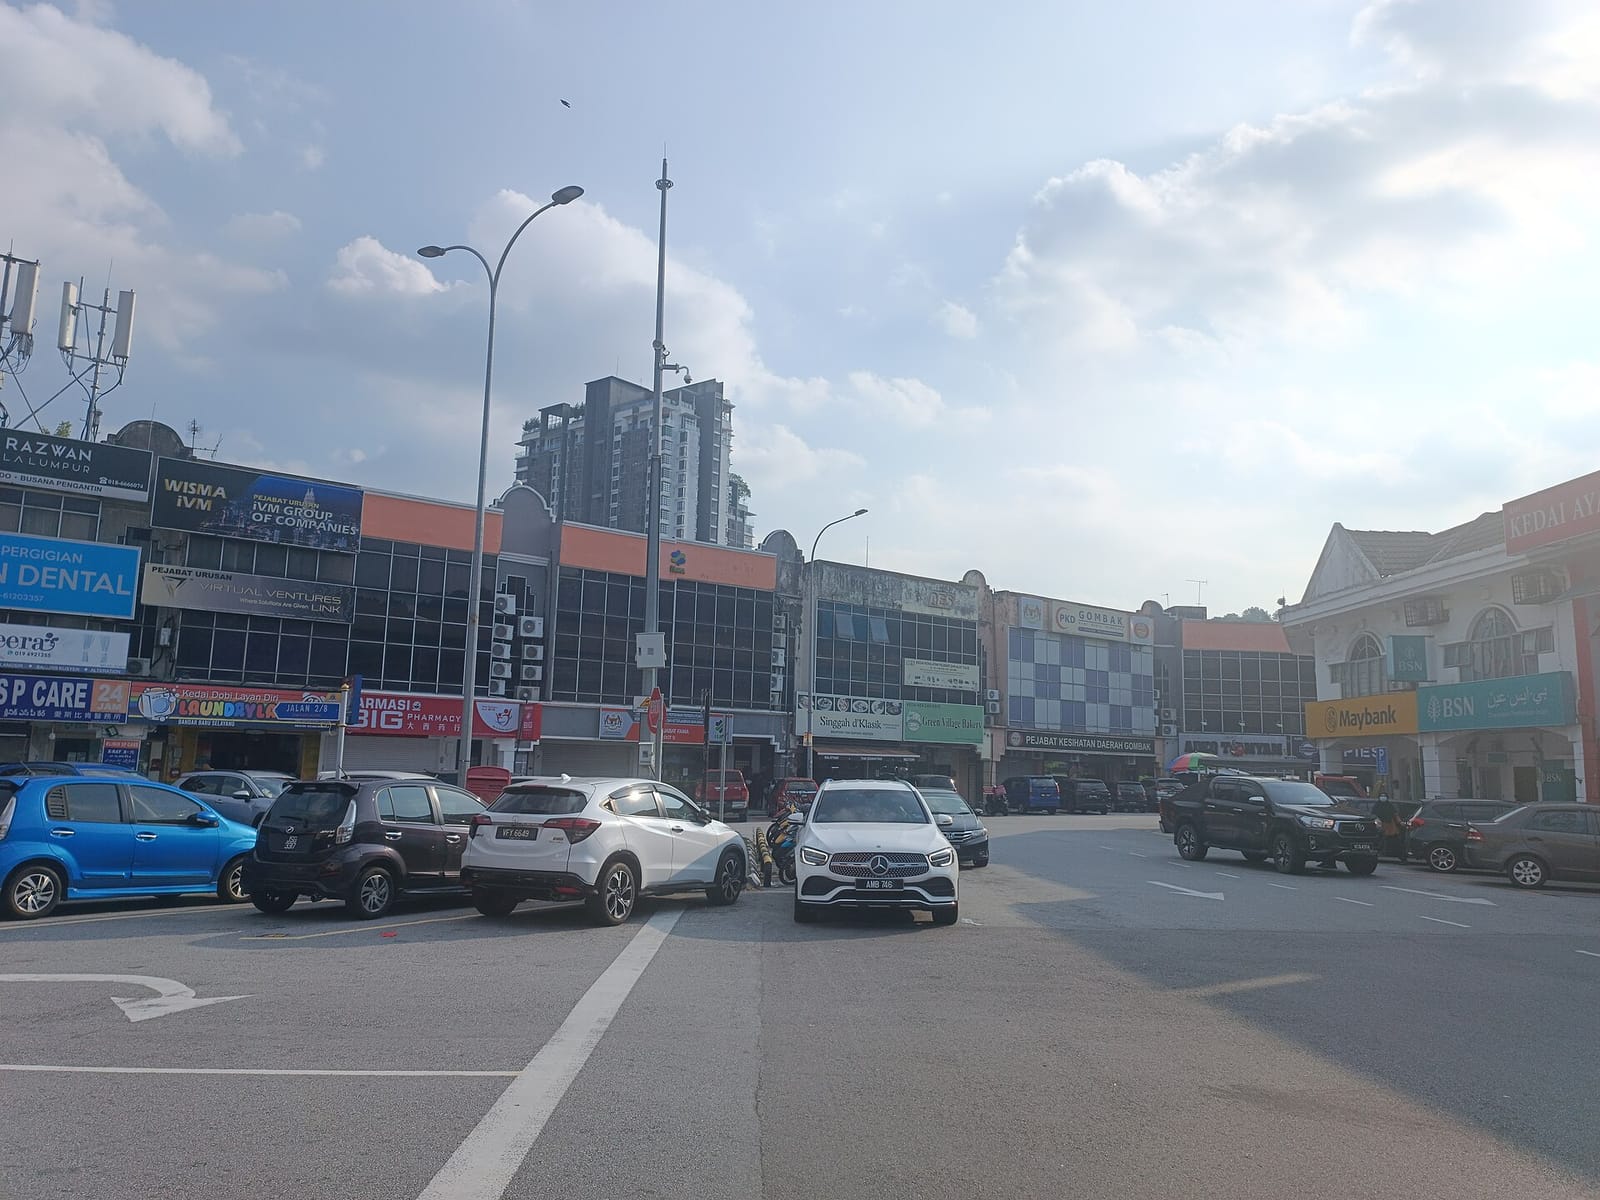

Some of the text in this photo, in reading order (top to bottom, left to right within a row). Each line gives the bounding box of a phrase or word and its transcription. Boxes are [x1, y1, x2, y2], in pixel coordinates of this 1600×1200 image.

[6, 437, 92, 462] RAZWAN
[20, 475, 55, 486] BUSANA
[56, 480, 103, 493] PENGANTIN
[164, 479, 227, 498] WISMA
[253, 494, 288, 505] PEJABAT
[283, 507, 333, 522] GROUP
[1510, 492, 1600, 538] KEDAI AY
[252, 512, 359, 535] OF COMPANIES
[1, 545, 83, 563] PERGIGIAN
[18, 564, 131, 596] DENTAL
[152, 566, 233, 582] PEJABAT URUSAN
[200, 583, 342, 605] VIRTUAL VENTURES
[311, 605, 340, 613] LINK
[1060, 614, 1076, 624] PKD
[1078, 610, 1123, 625] GOMBAK
[1400, 660, 1422, 671] BSN
[32, 680, 88, 708] CARE
[97, 684, 124, 703] 24
[182, 689, 279, 703] Kedai Dobi Layan Diri
[286, 704, 328, 713] JALAN 2/8
[1443, 696, 1475, 718] BSN
[349, 709, 403, 730] BIG
[407, 713, 462, 722] PHARMACY
[819, 716, 851, 729] Singgah
[852, 717, 882, 729] d'Klasik
[922, 716, 982, 729] Green Village Bakery
[1339, 705, 1397, 731] Maybank
[1026, 736, 1057, 745] PEJABAT
[1058, 737, 1096, 748] KESIHATAN
[1097, 740, 1123, 749] DAERAH
[1124, 741, 1151, 751] GOMBAK
[866, 880, 893, 889] AMB 746
